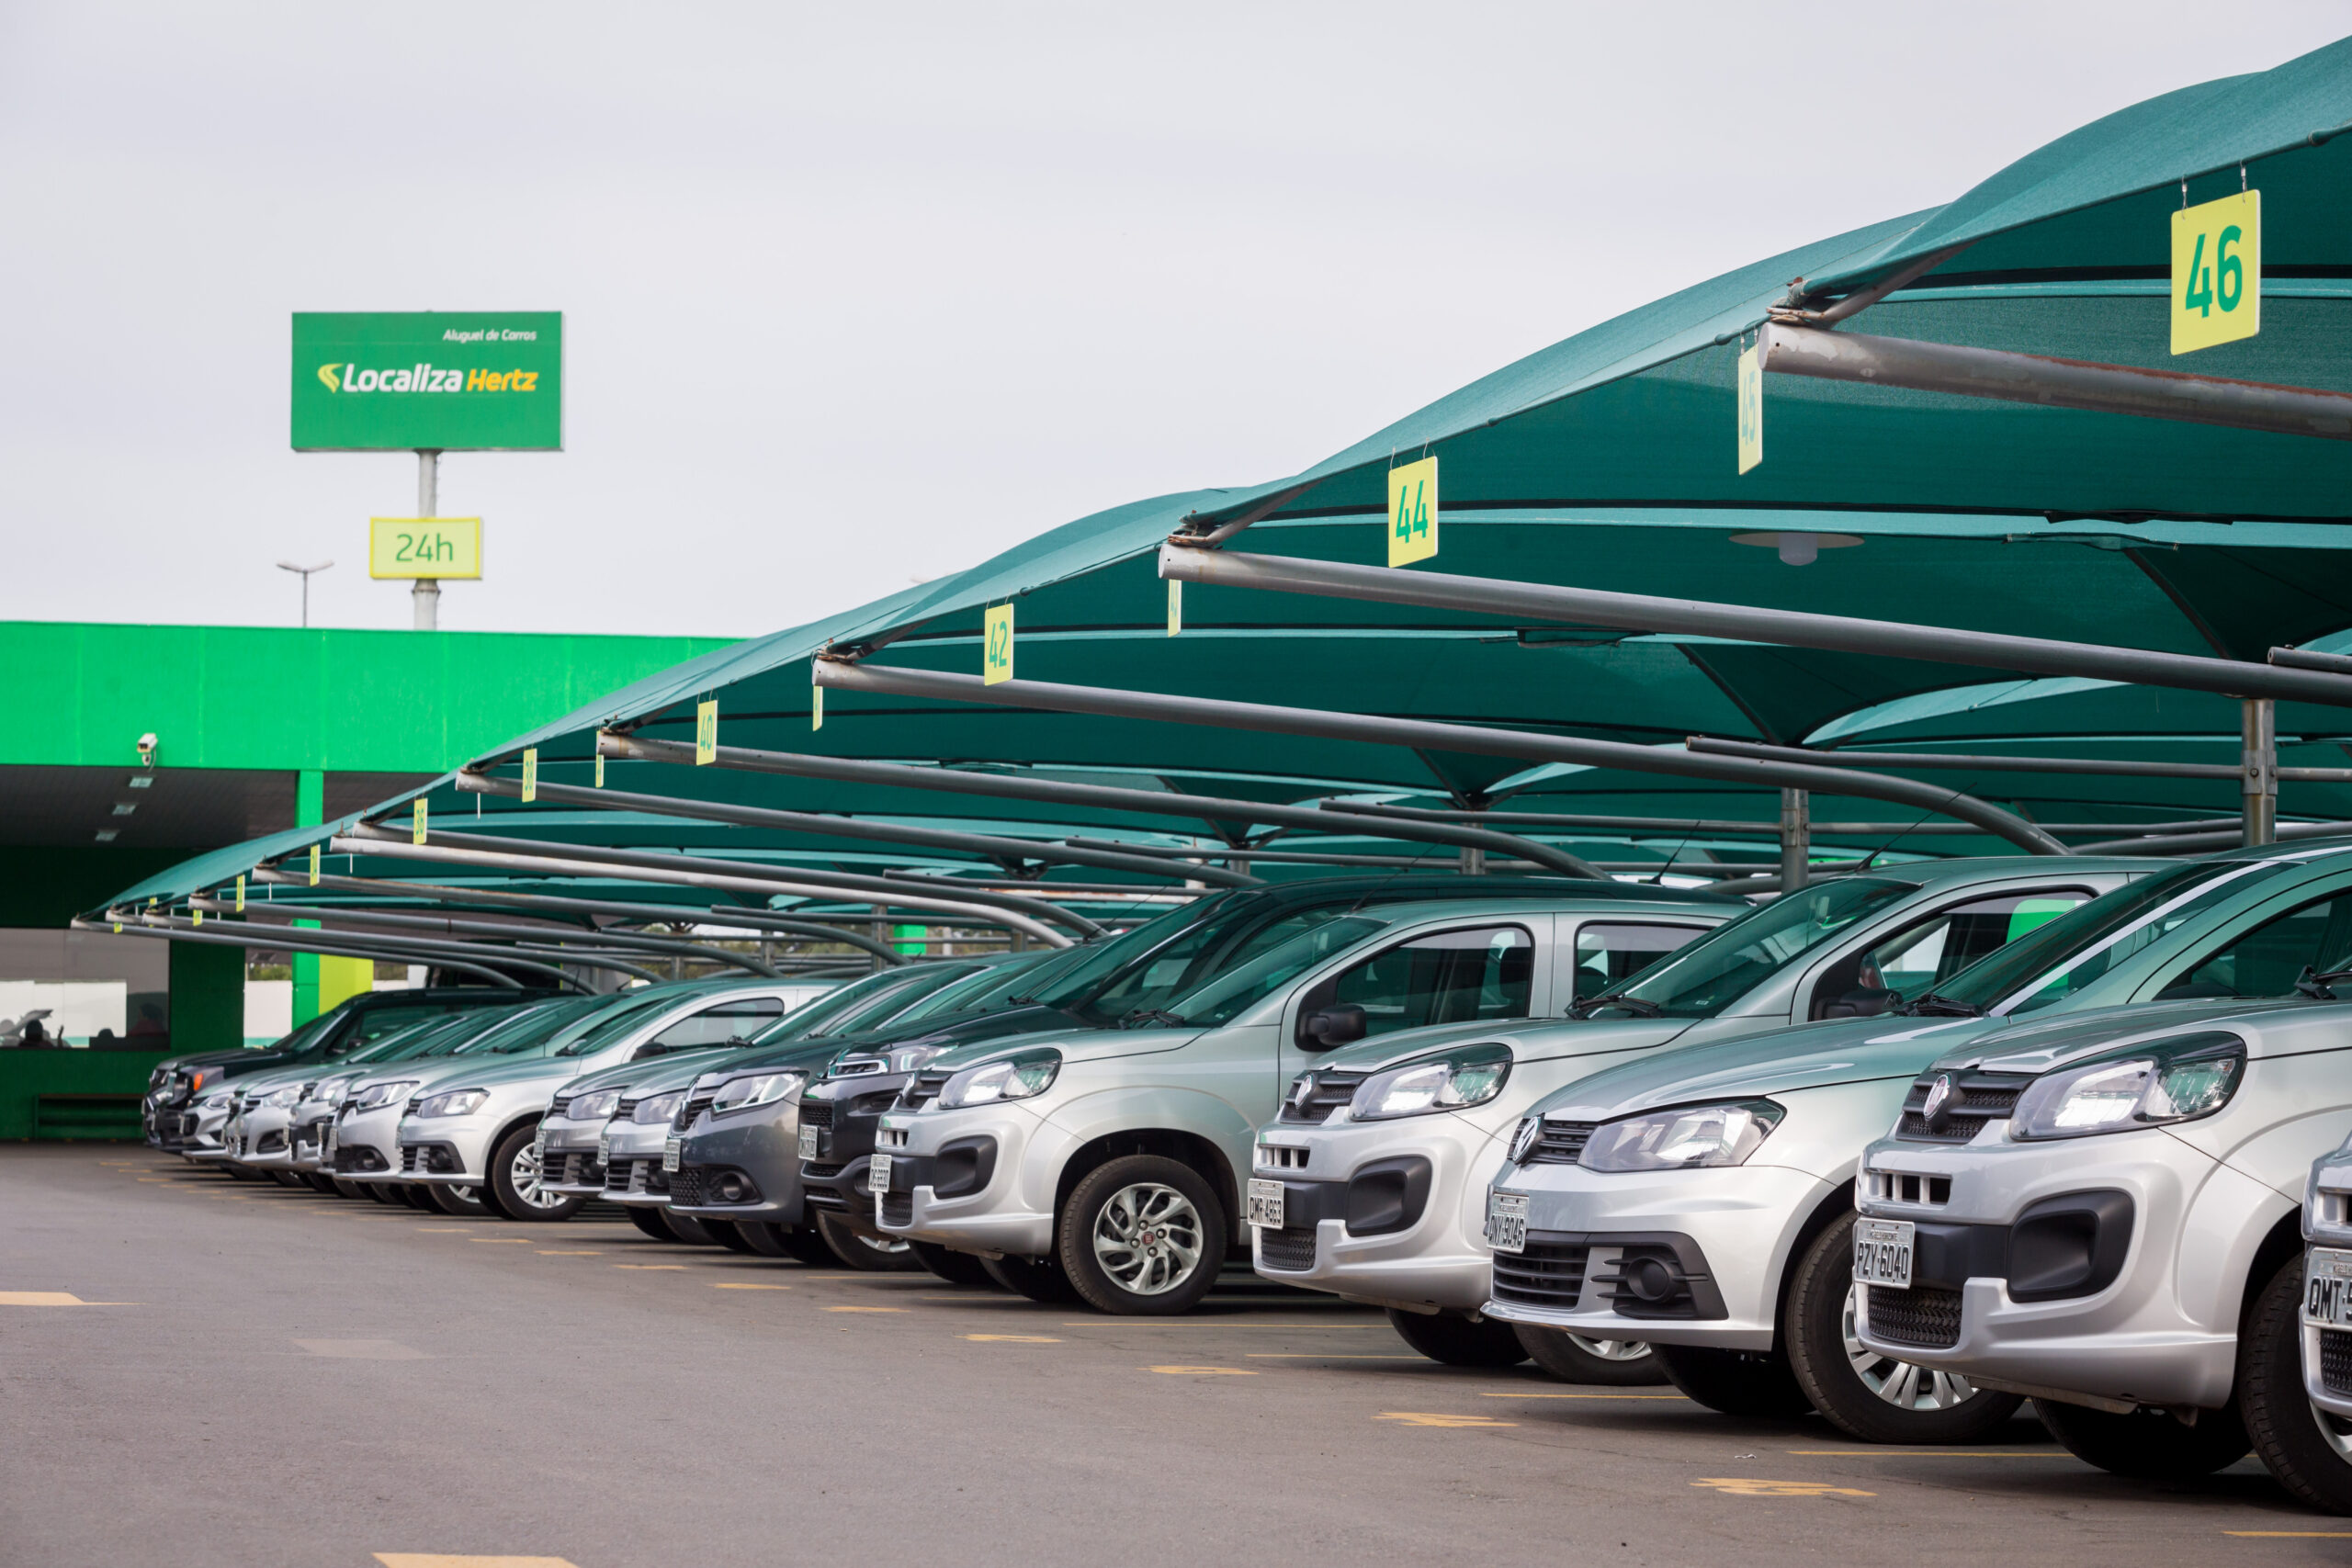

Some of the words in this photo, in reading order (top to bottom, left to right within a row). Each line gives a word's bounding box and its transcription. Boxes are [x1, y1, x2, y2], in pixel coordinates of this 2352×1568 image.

[2185, 225, 2243, 319] 46
[442, 329, 484, 344] Aluguel
[485, 329, 499, 342] de
[501, 329, 537, 342] Carros
[342, 363, 463, 393] Localiza
[466, 368, 539, 392] Hertz
[1741, 370, 1756, 446] 45
[1396, 479, 1429, 544] 44
[395, 532, 454, 562] 24h
[989, 620, 1008, 669] 42
[700, 714, 713, 751] 40
